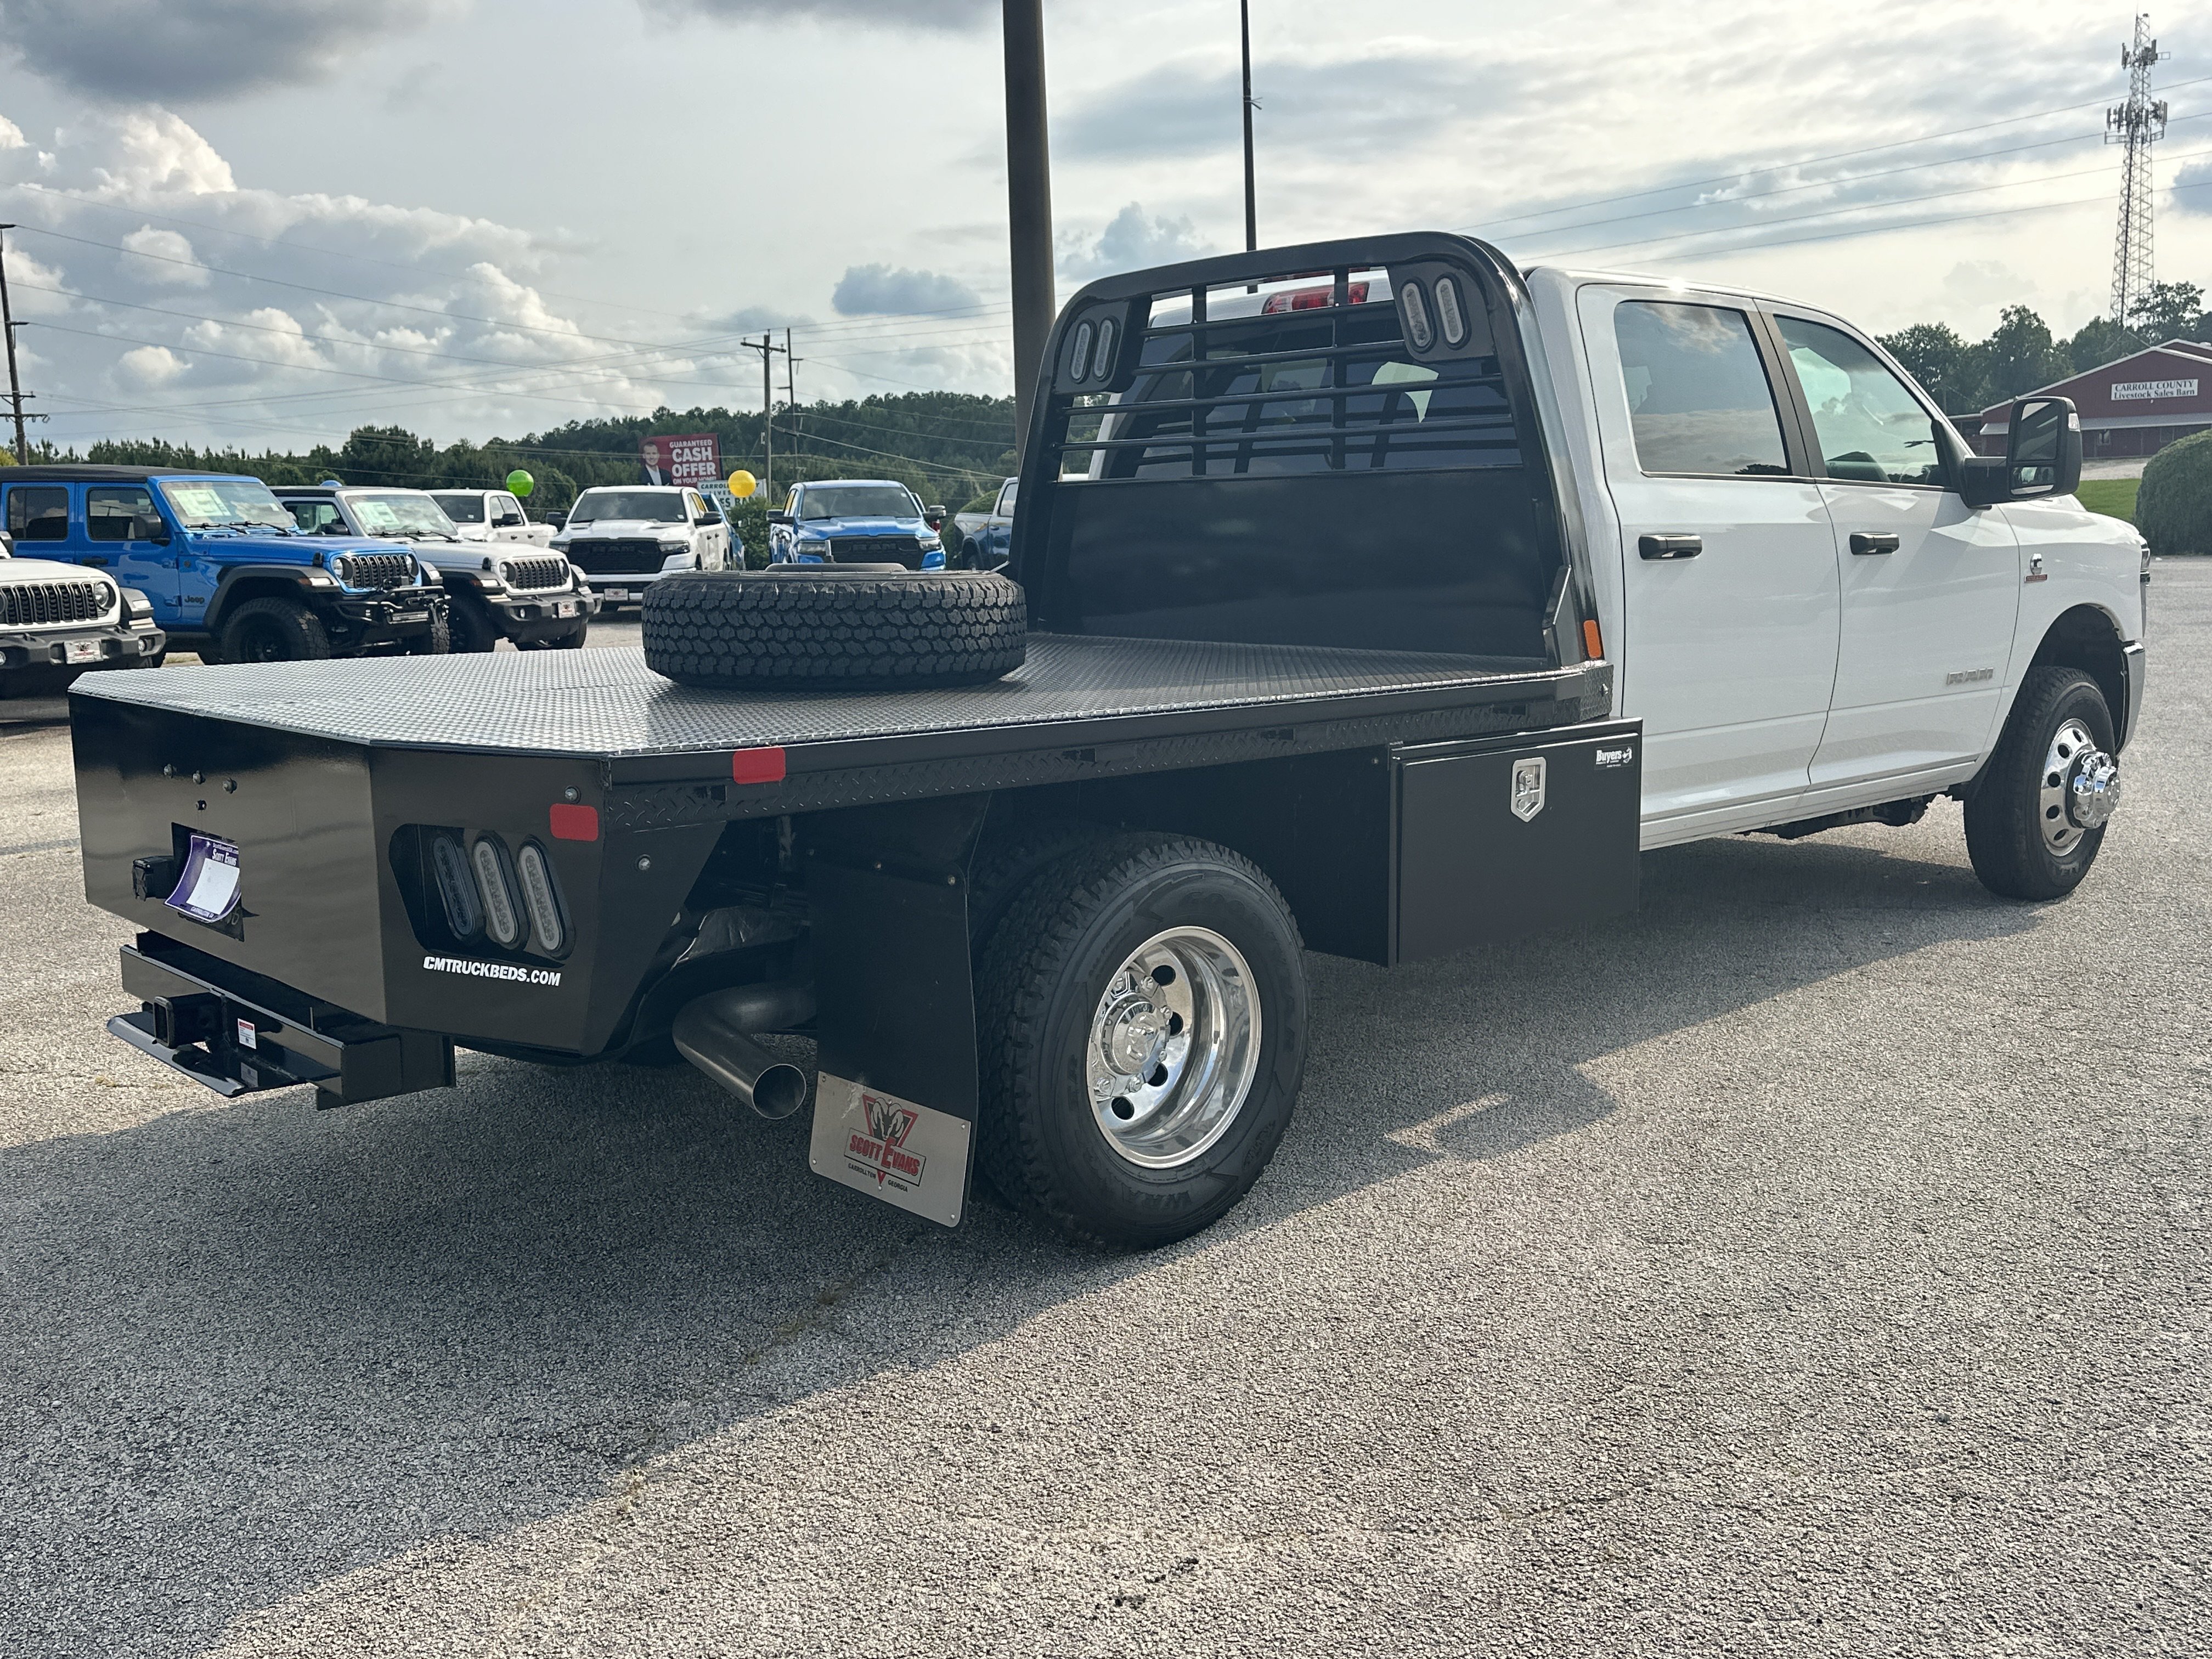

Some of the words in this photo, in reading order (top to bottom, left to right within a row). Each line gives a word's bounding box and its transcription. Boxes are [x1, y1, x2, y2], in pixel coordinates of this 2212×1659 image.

[2115, 382, 2154, 392] CARROLL
[2157, 380, 2194, 390] COUNTY
[2114, 390, 2151, 399] Livestock
[2154, 390, 2174, 398] Sales
[669, 439, 713, 448] GUARANTEED
[672, 447, 713, 462] CASH
[672, 462, 716, 477] OFFER
[184, 595, 205, 604] Jeep
[1946, 668, 1993, 685] RAM
[1596, 750, 1622, 764] Buyers
[423, 956, 561, 986] CMTRUCKBEDS.COM
[850, 1135, 883, 1161] SCOTT
[881, 1136, 920, 1176] EVANS
[848, 1163, 877, 1179] CARROLLTON
[888, 1180, 908, 1193] GEORGIA
